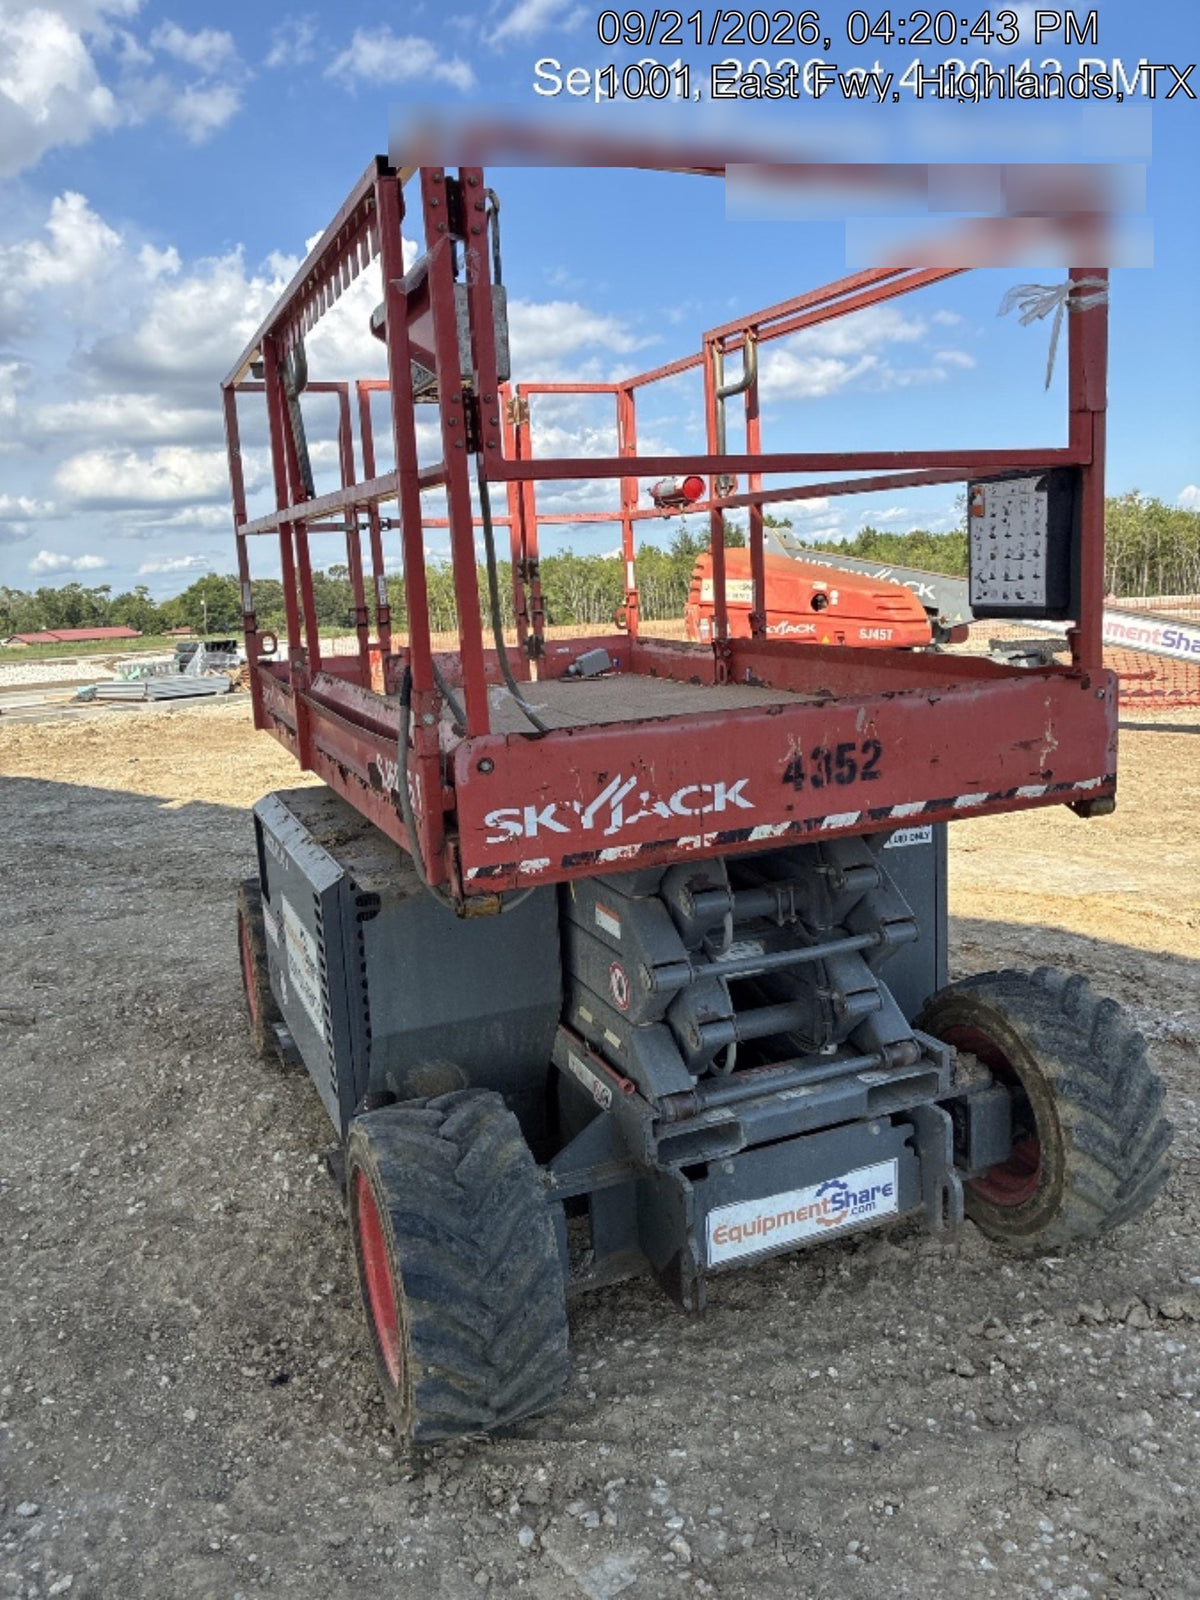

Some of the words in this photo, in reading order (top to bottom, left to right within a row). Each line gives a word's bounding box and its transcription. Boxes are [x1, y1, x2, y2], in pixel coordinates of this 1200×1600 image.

[766, 620, 816, 635] KYJACK
[859, 628, 894, 641] SJ45T
[782, 738, 883, 793] 4352
[484, 774, 755, 844] SKYJACK
[712, 1182, 894, 1246] EquipmentShare
[850, 1201, 876, 1216] .com
